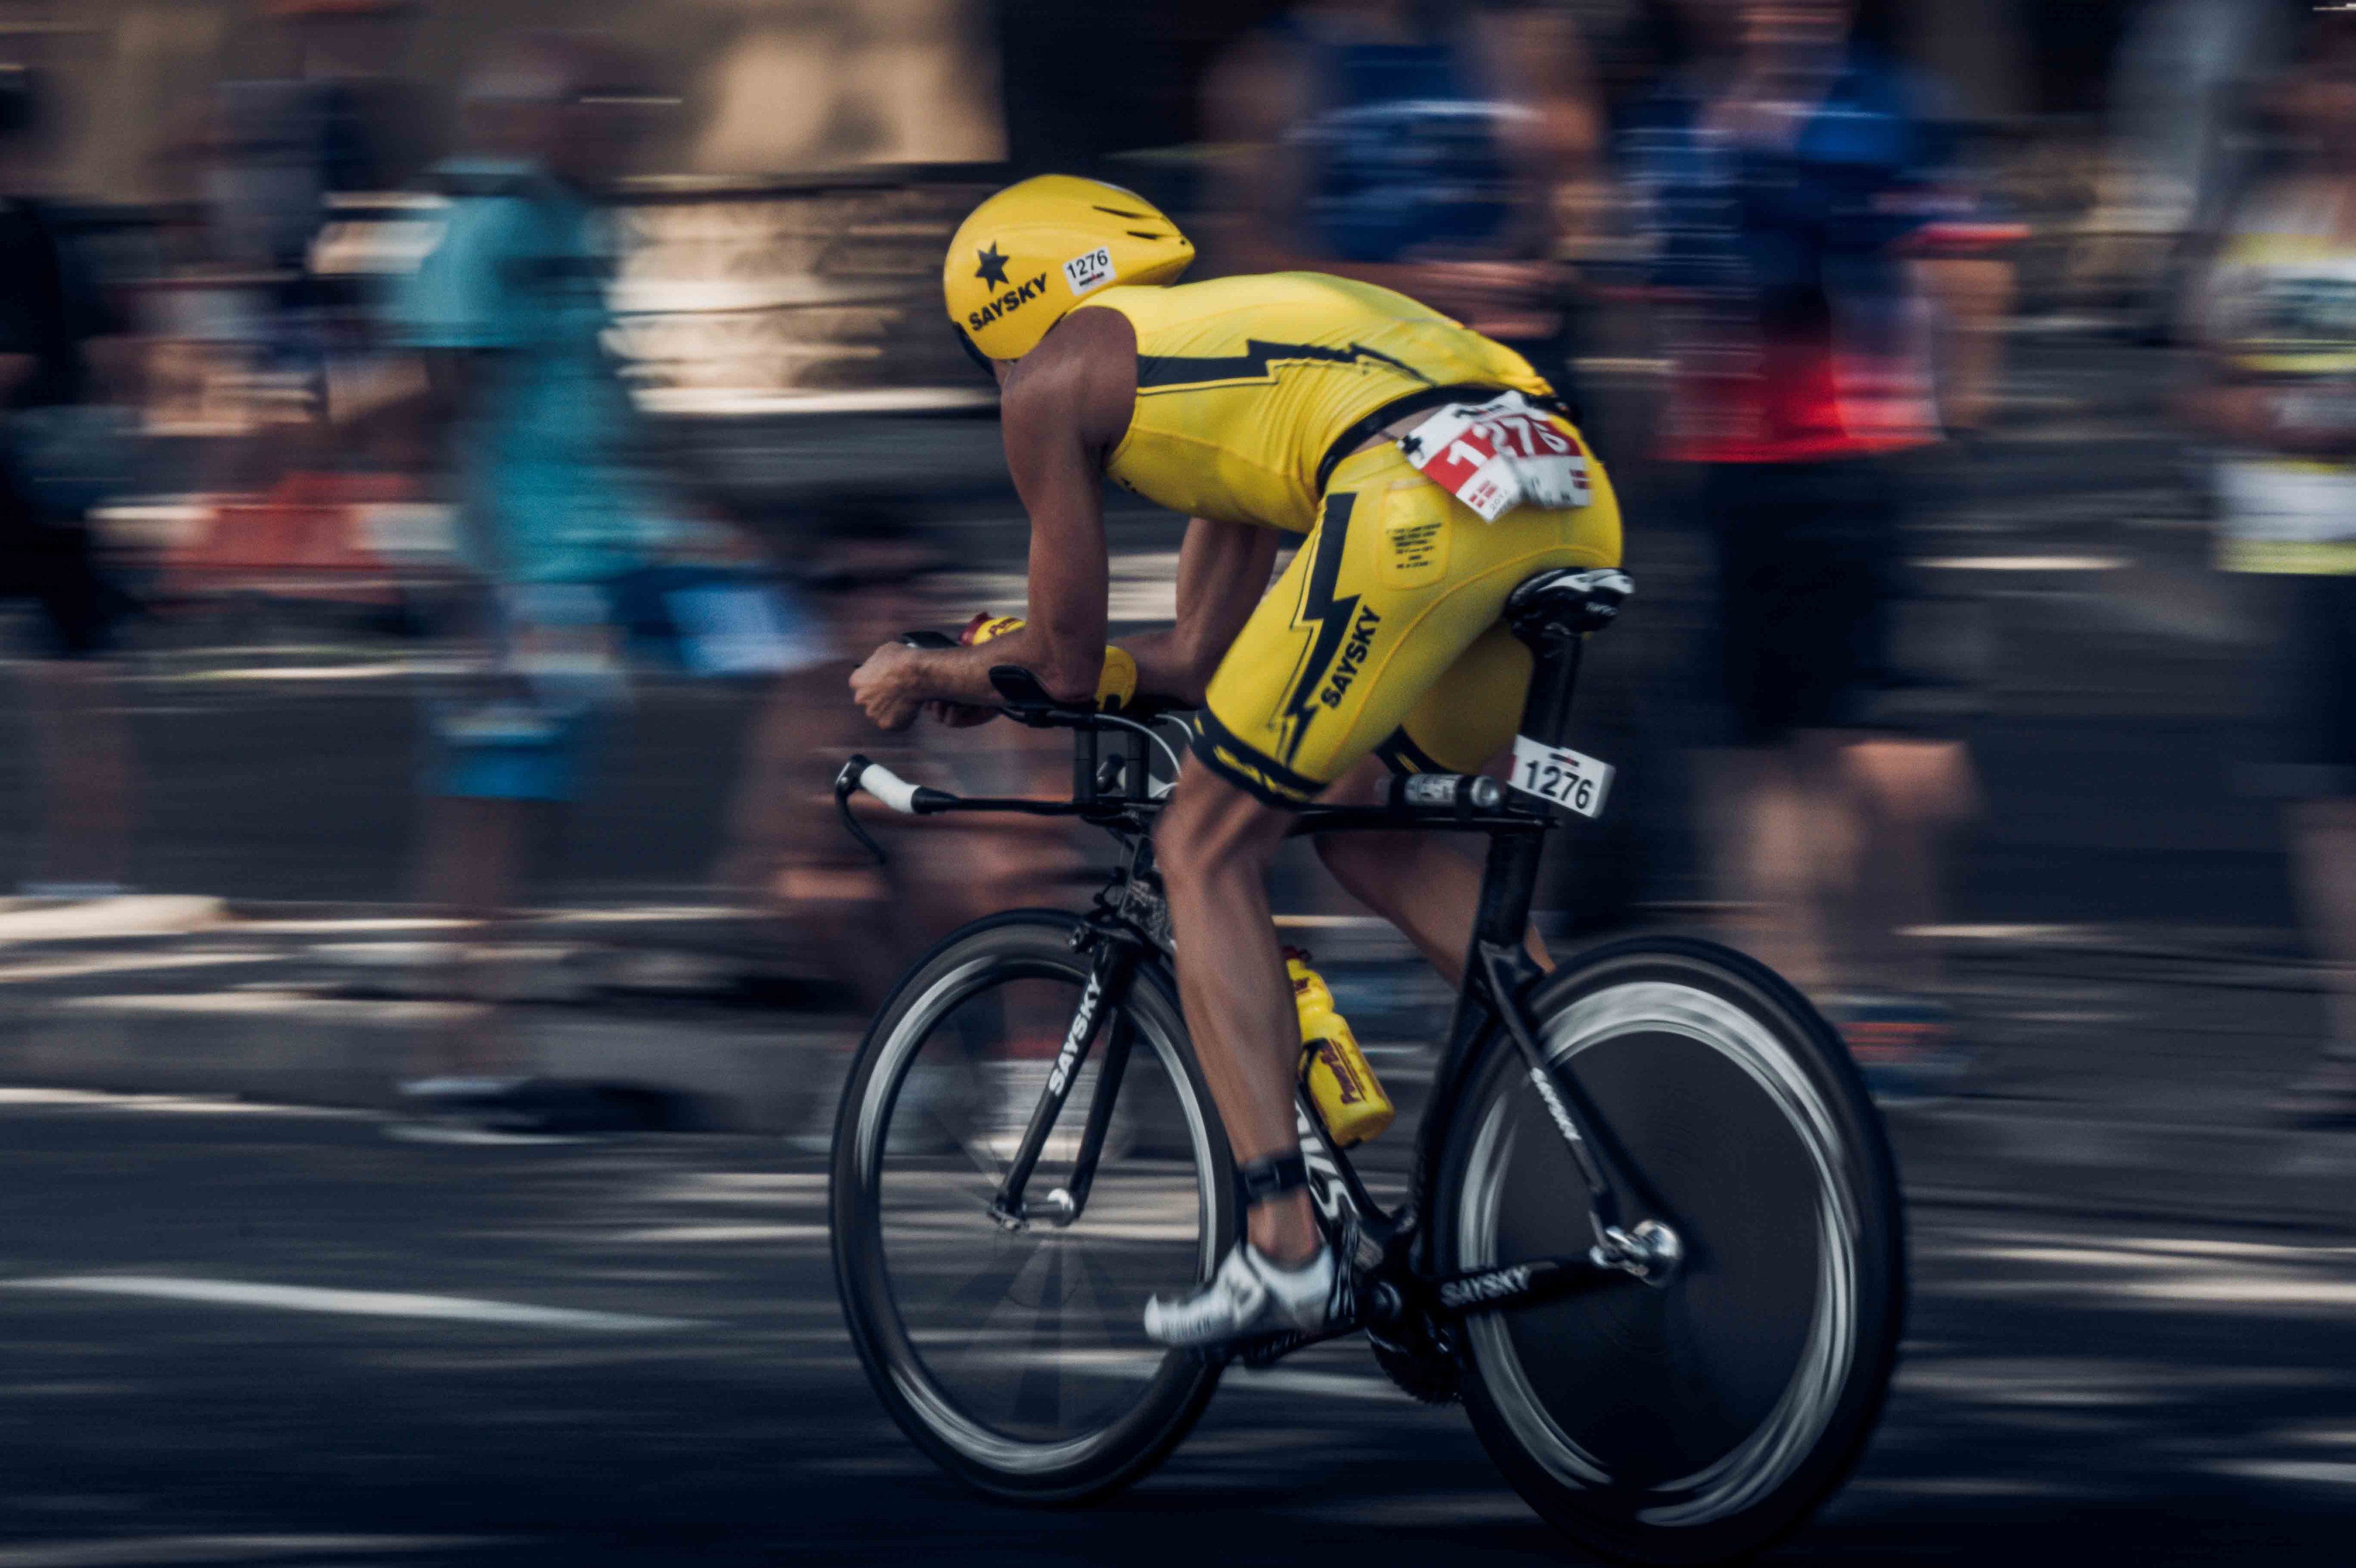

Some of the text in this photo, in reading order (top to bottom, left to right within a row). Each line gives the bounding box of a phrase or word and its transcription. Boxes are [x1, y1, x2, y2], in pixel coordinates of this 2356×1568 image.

[1066, 250, 1108, 278] 1276
[969, 272, 1047, 331] SAYSKY
[1447, 415, 1570, 466] 1276
[1321, 605, 1380, 709] SAYSKY
[1525, 759, 1593, 810] 1276
[1049, 971, 1101, 1097] SAYSKY
